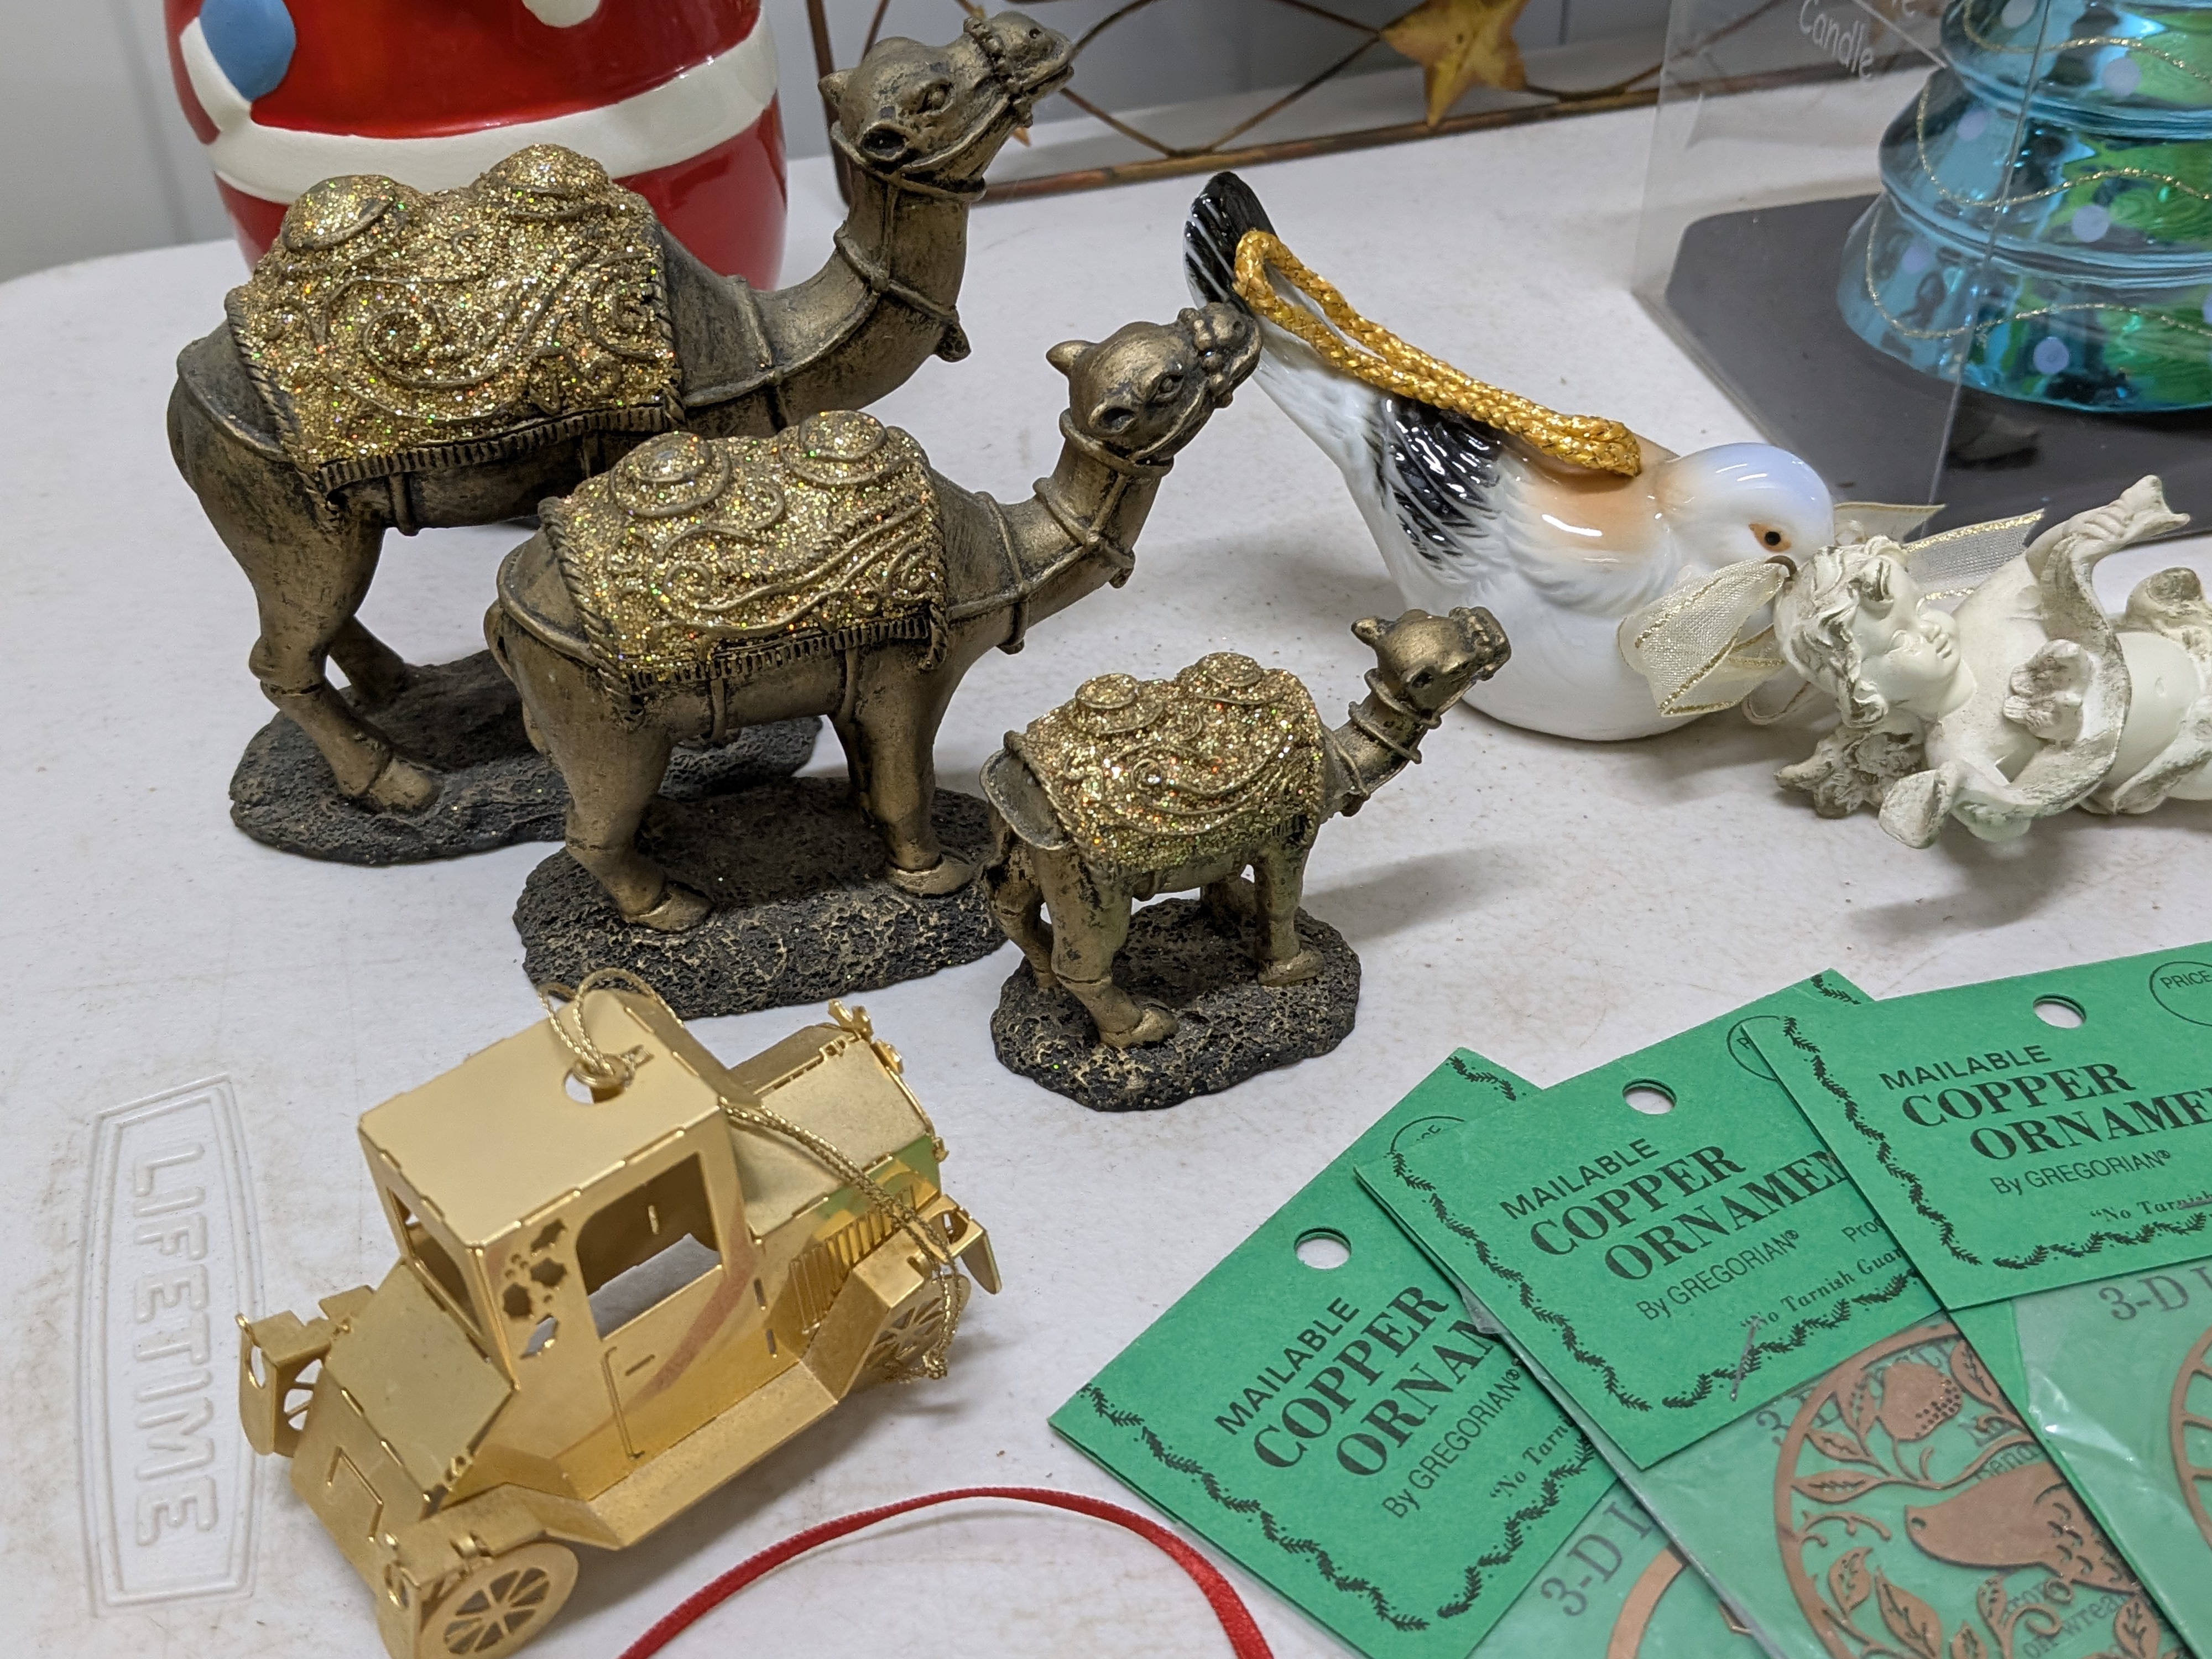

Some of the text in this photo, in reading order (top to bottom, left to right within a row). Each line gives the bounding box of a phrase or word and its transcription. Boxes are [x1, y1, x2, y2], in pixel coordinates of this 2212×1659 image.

[1799, 0, 1874, 78] Candle
[2159, 970, 2212, 989] PRICE
[1880, 1045, 2052, 1091] MAILABLE
[1902, 1063, 2136, 1128] COPPER
[1970, 1087, 2212, 1160] ORNAME
[1499, 1138, 1658, 1220] MAILABLE
[1530, 1146, 1746, 1256] COPPER
[1990, 1176, 2023, 1196] By
[1636, 1298, 1670, 1321] By
[1780, 1270, 1855, 1312] Tarnish
[2099, 1275, 2189, 1320] 3-D
[131, 1142, 219, 1547] LIFETIME
[1215, 1297, 1359, 1434] MAILABLE
[1253, 1286, 1448, 1468] COPPER
[1382, 1489, 1420, 1518] By
[1541, 1533, 1623, 1617] 3-D
